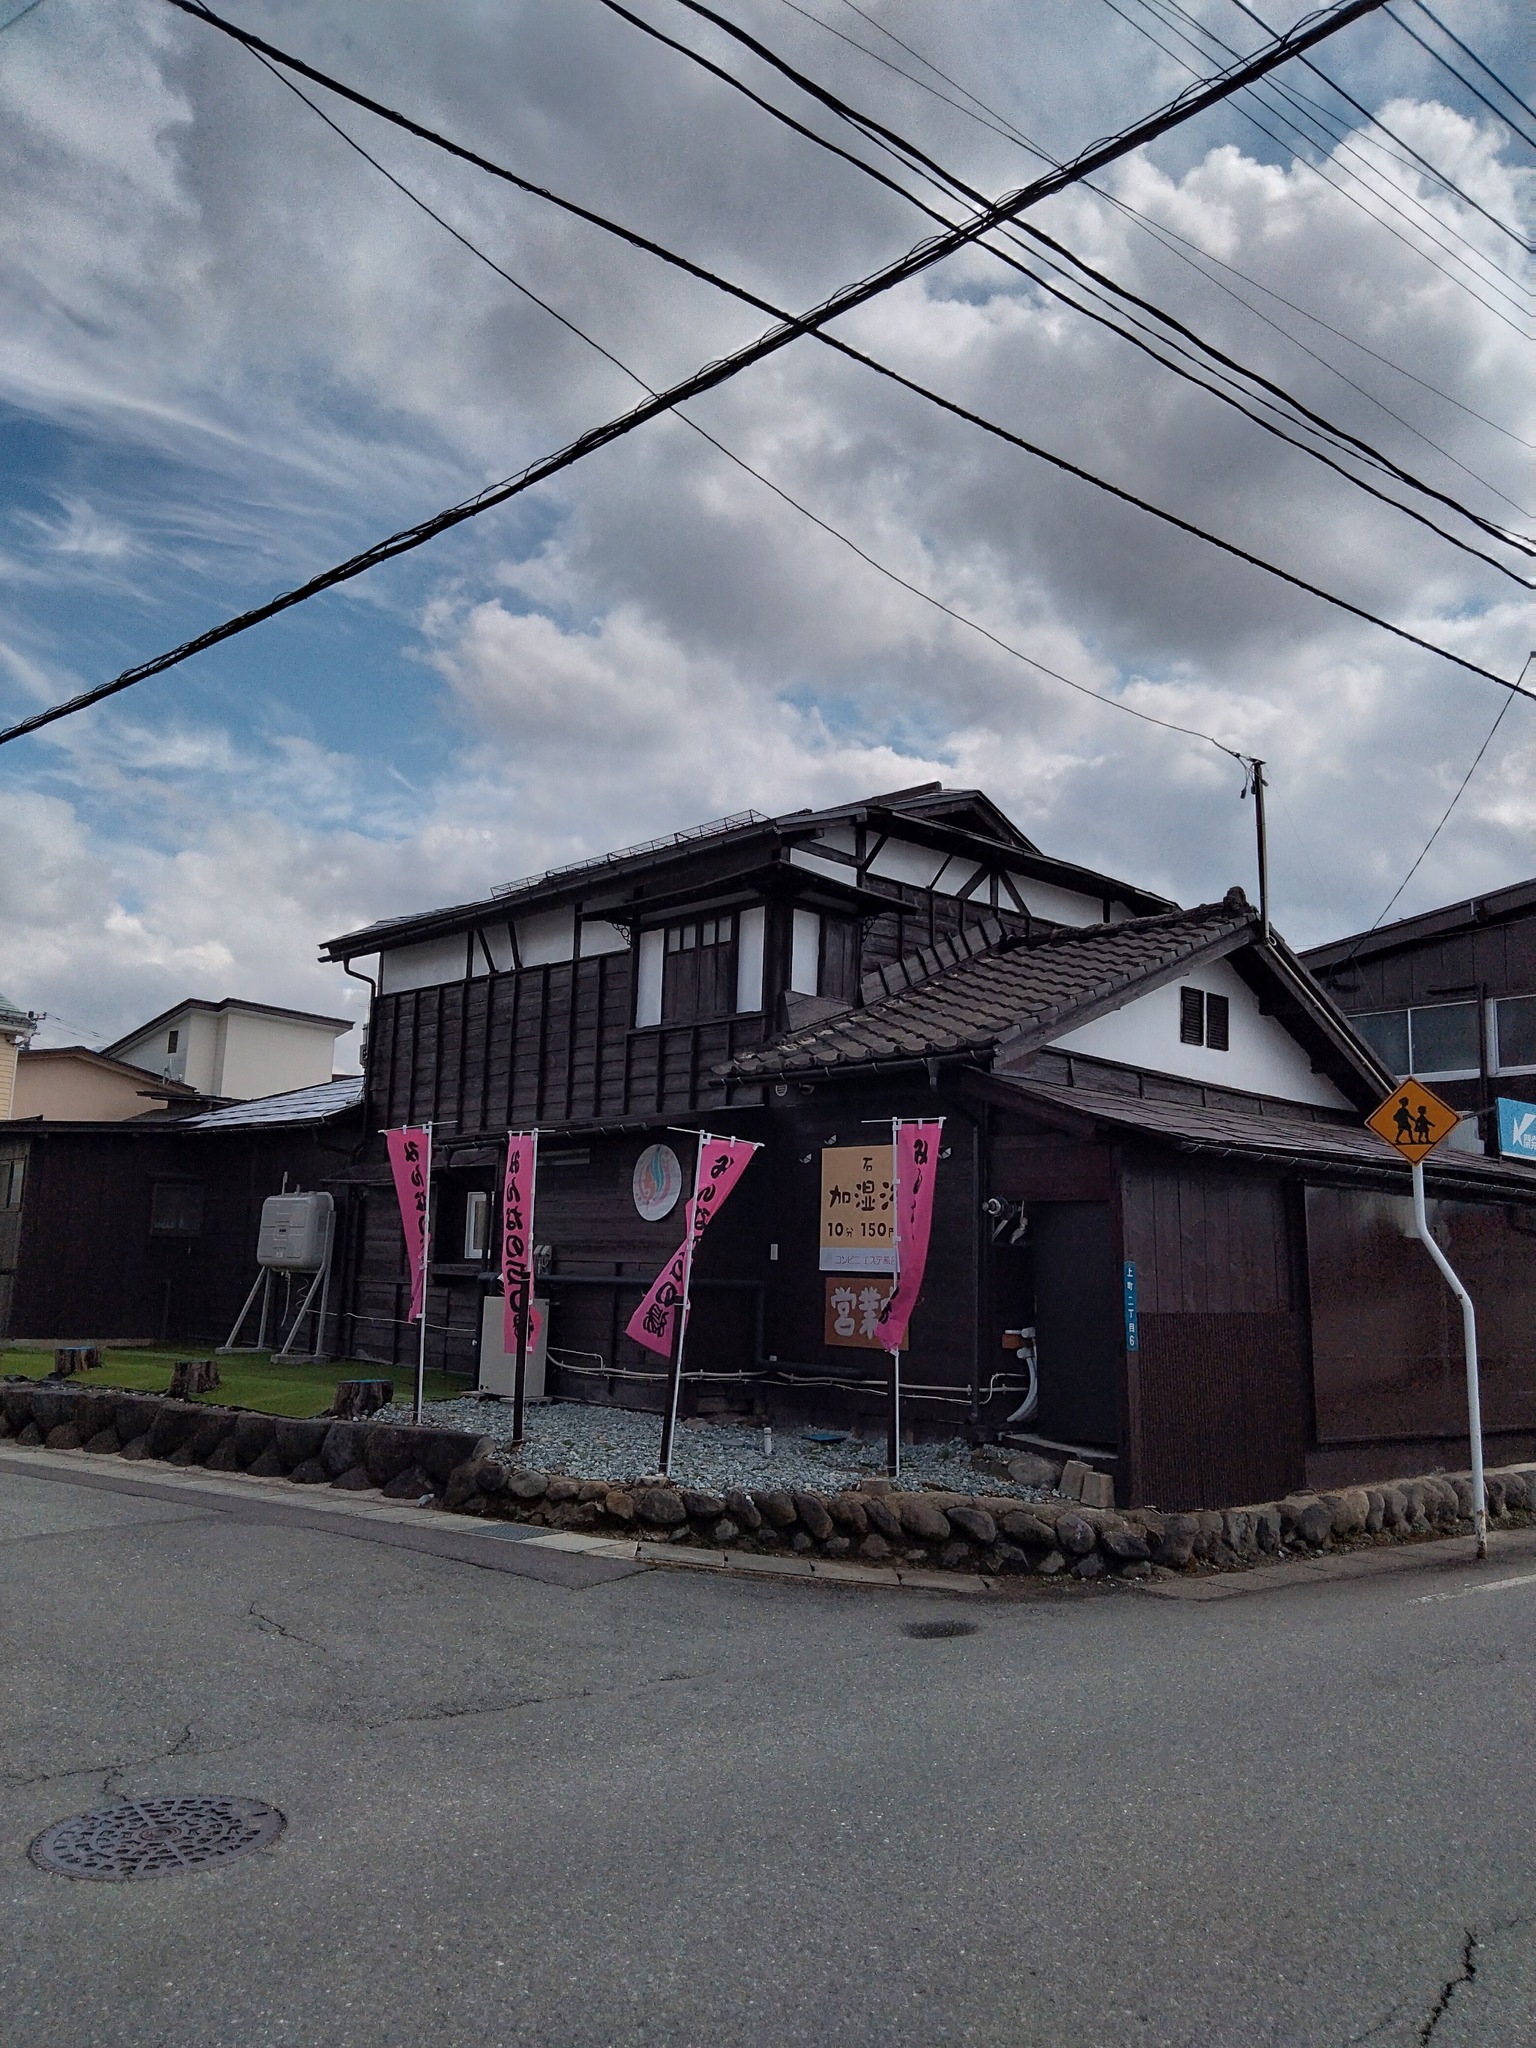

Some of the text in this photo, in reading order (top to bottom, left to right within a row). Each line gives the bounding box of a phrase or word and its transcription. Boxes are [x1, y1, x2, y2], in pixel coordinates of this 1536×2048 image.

[863, 1157, 873, 1172] 石
[1126, 1267, 1136, 1347] 上町二丁目6
